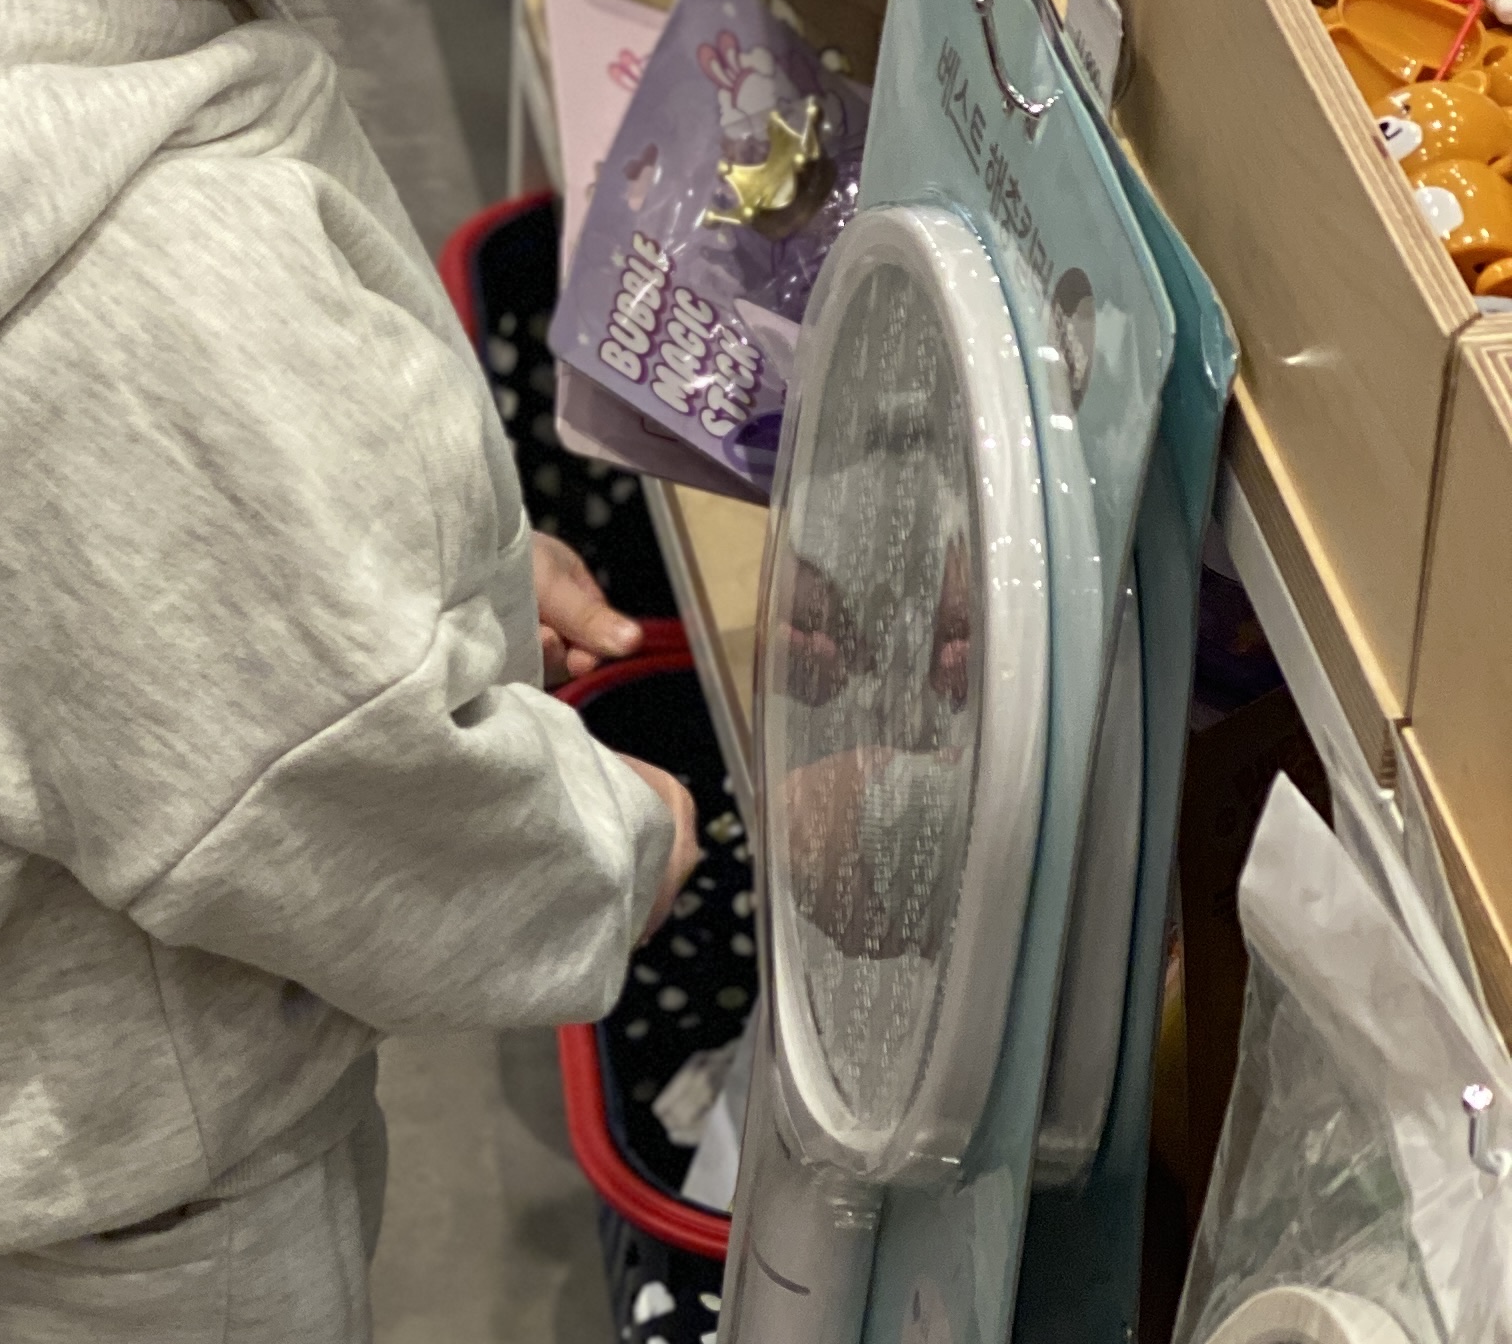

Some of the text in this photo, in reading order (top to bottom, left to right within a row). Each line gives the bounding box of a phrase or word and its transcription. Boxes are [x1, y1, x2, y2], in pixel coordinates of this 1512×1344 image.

[937, 36, 987, 175] 베스트
[599, 231, 673, 384] BUBBLE
[650, 286, 718, 416] MAGIC
[699, 325, 763, 438] STICK
